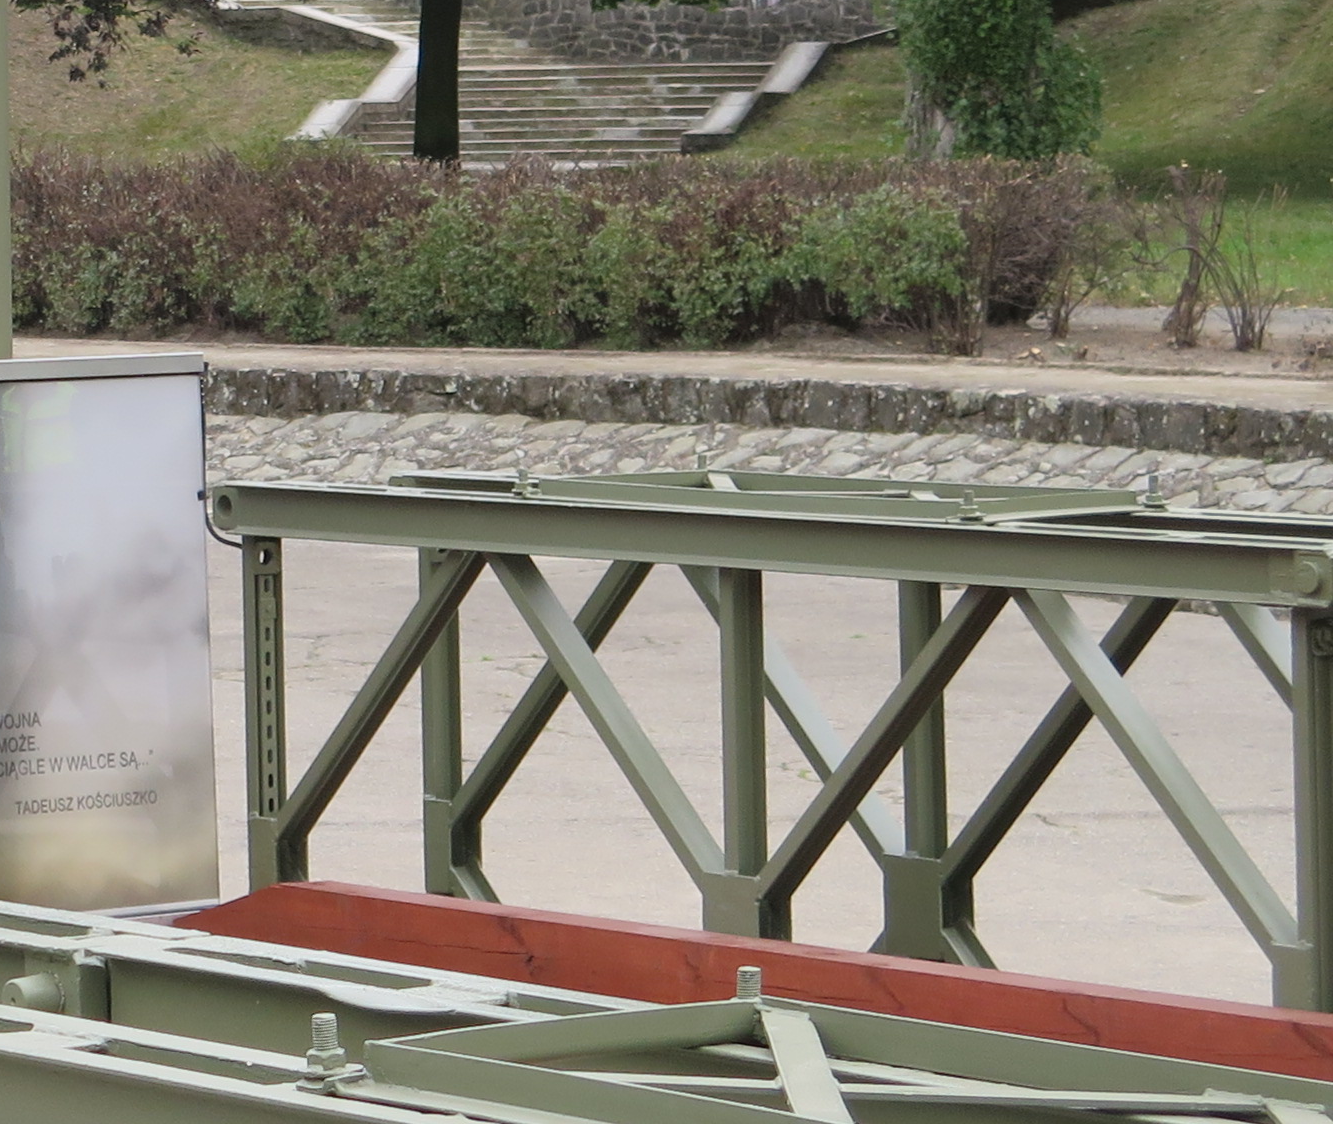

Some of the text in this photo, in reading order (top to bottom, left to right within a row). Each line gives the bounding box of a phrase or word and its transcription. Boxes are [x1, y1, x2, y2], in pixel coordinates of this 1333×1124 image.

[49, 757, 65, 773] W
[65, 754, 115, 772] WALCE
[15, 790, 158, 816] TADEUSZ KOŚCIUSZKO
